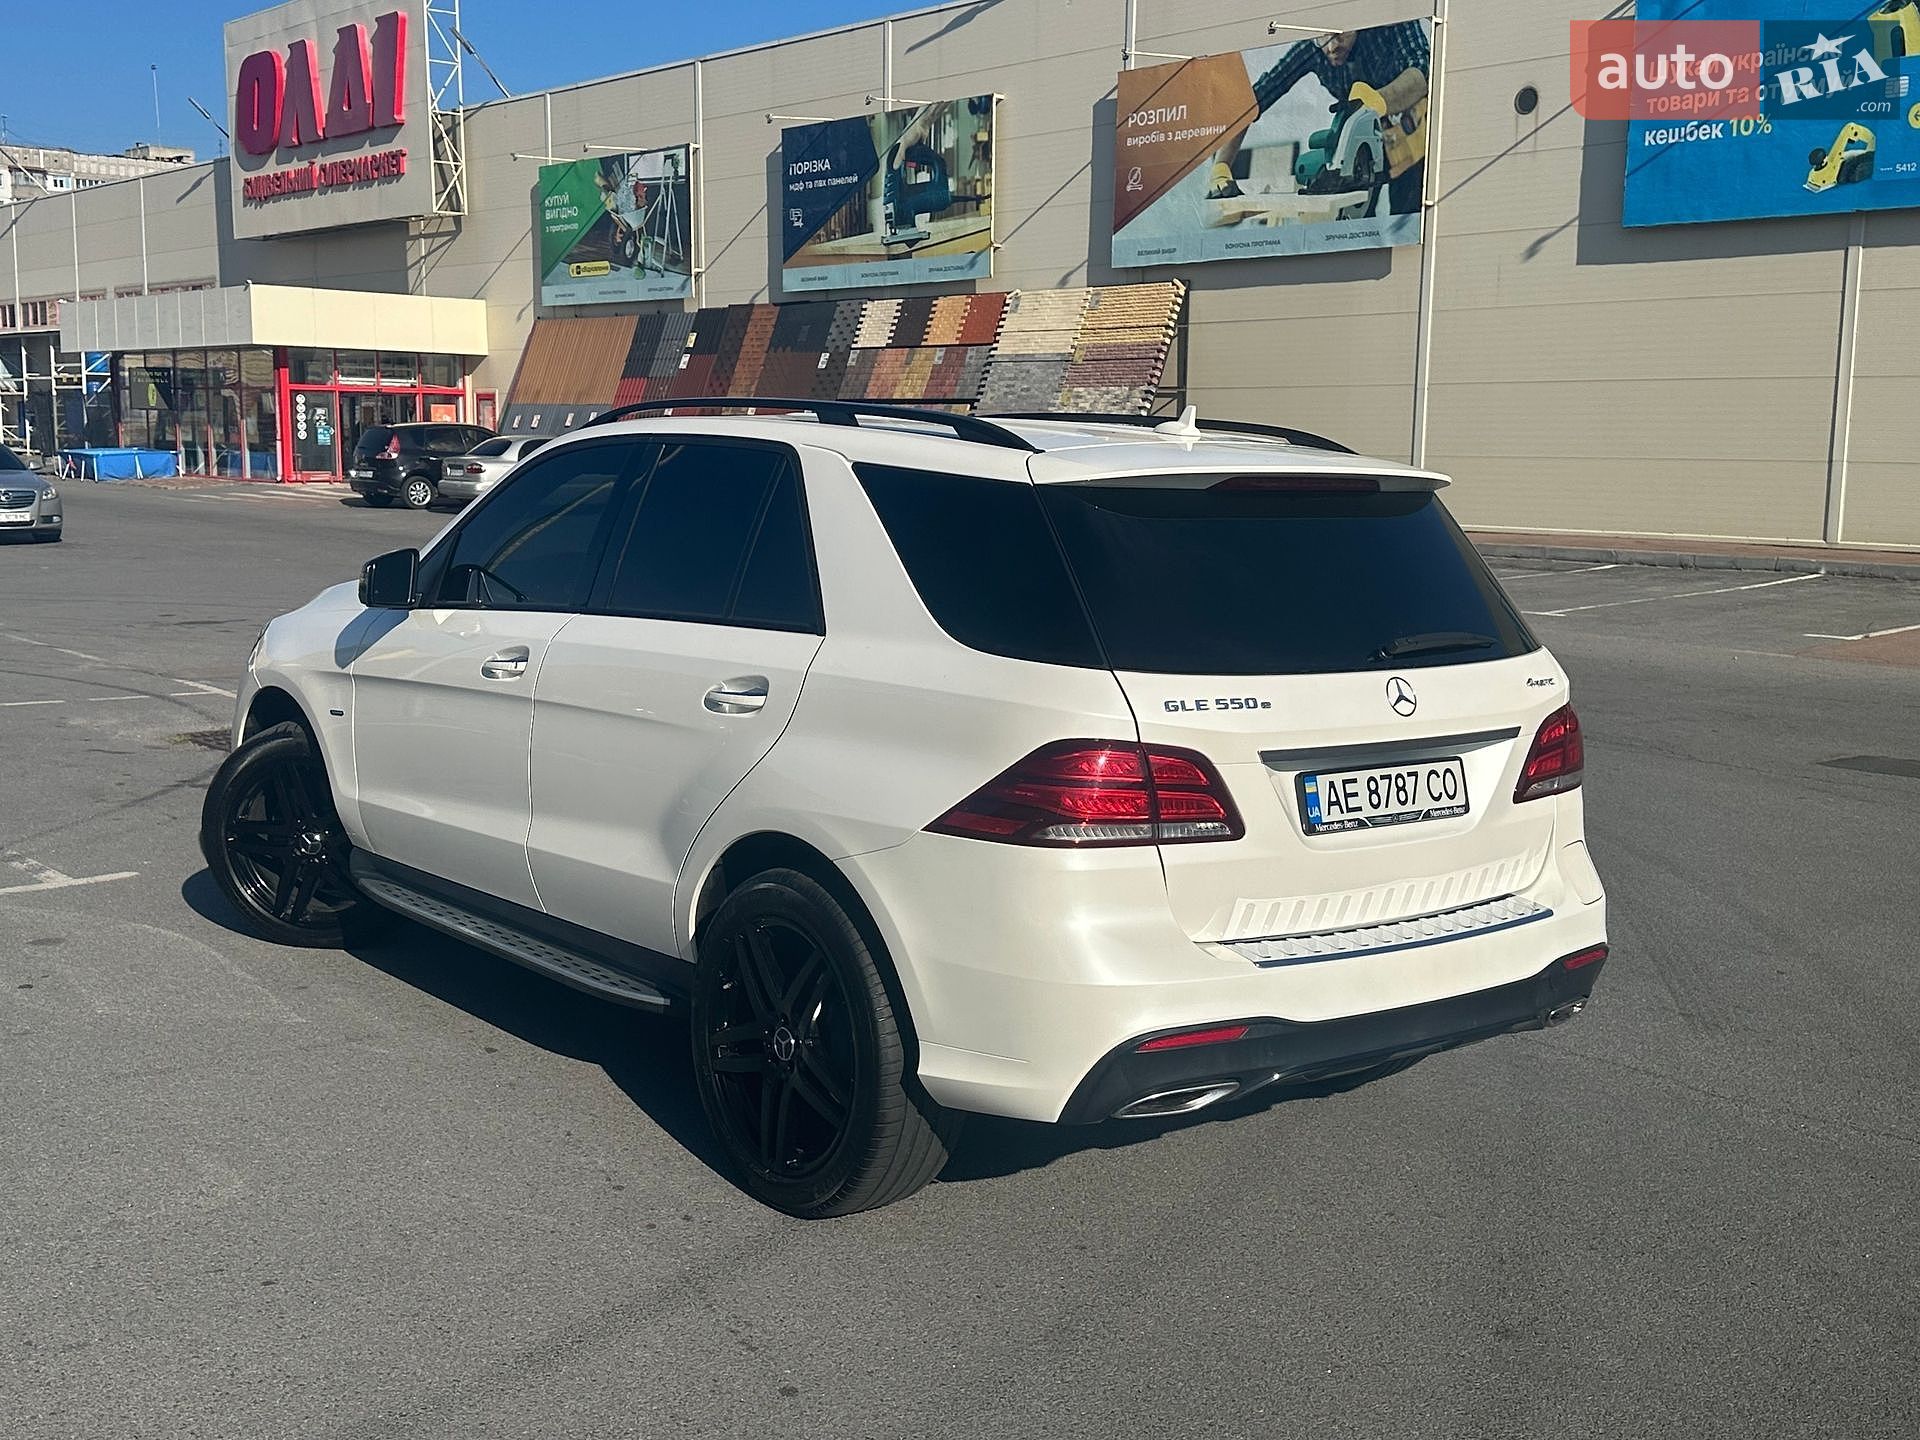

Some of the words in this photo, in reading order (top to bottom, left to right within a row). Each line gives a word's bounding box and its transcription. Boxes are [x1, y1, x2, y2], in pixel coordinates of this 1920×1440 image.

[236, 10, 407, 156] ОЛДІ
[1647, 90, 1720, 114] товари
[1726, 86, 1749, 105] та
[1127, 104, 1187, 128] РОЗПИЛ
[1126, 131, 1165, 148] виробів
[1167, 132, 1173, 141] з
[1174, 124, 1227, 142] деревини
[1644, 120, 1724, 146] кешбек
[1729, 112, 1773, 137] 10%
[789, 158, 831, 176] ПОРІЗКА
[1895, 162, 1917, 173] 5412
[805, 180, 813, 189] та
[827, 173, 858, 187] панелей
[544, 192, 570, 207] КУПУЙ
[1164, 699, 1210, 713] GLE
[1326, 777, 1363, 816] AE
[1366, 771, 1419, 810] 8787
[1426, 767, 1458, 802] CO
[1307, 807, 1321, 818] UA
[1429, 804, 1466, 818] Mercedes-Benz
[1314, 819, 1359, 832] Mercedes-Benz
